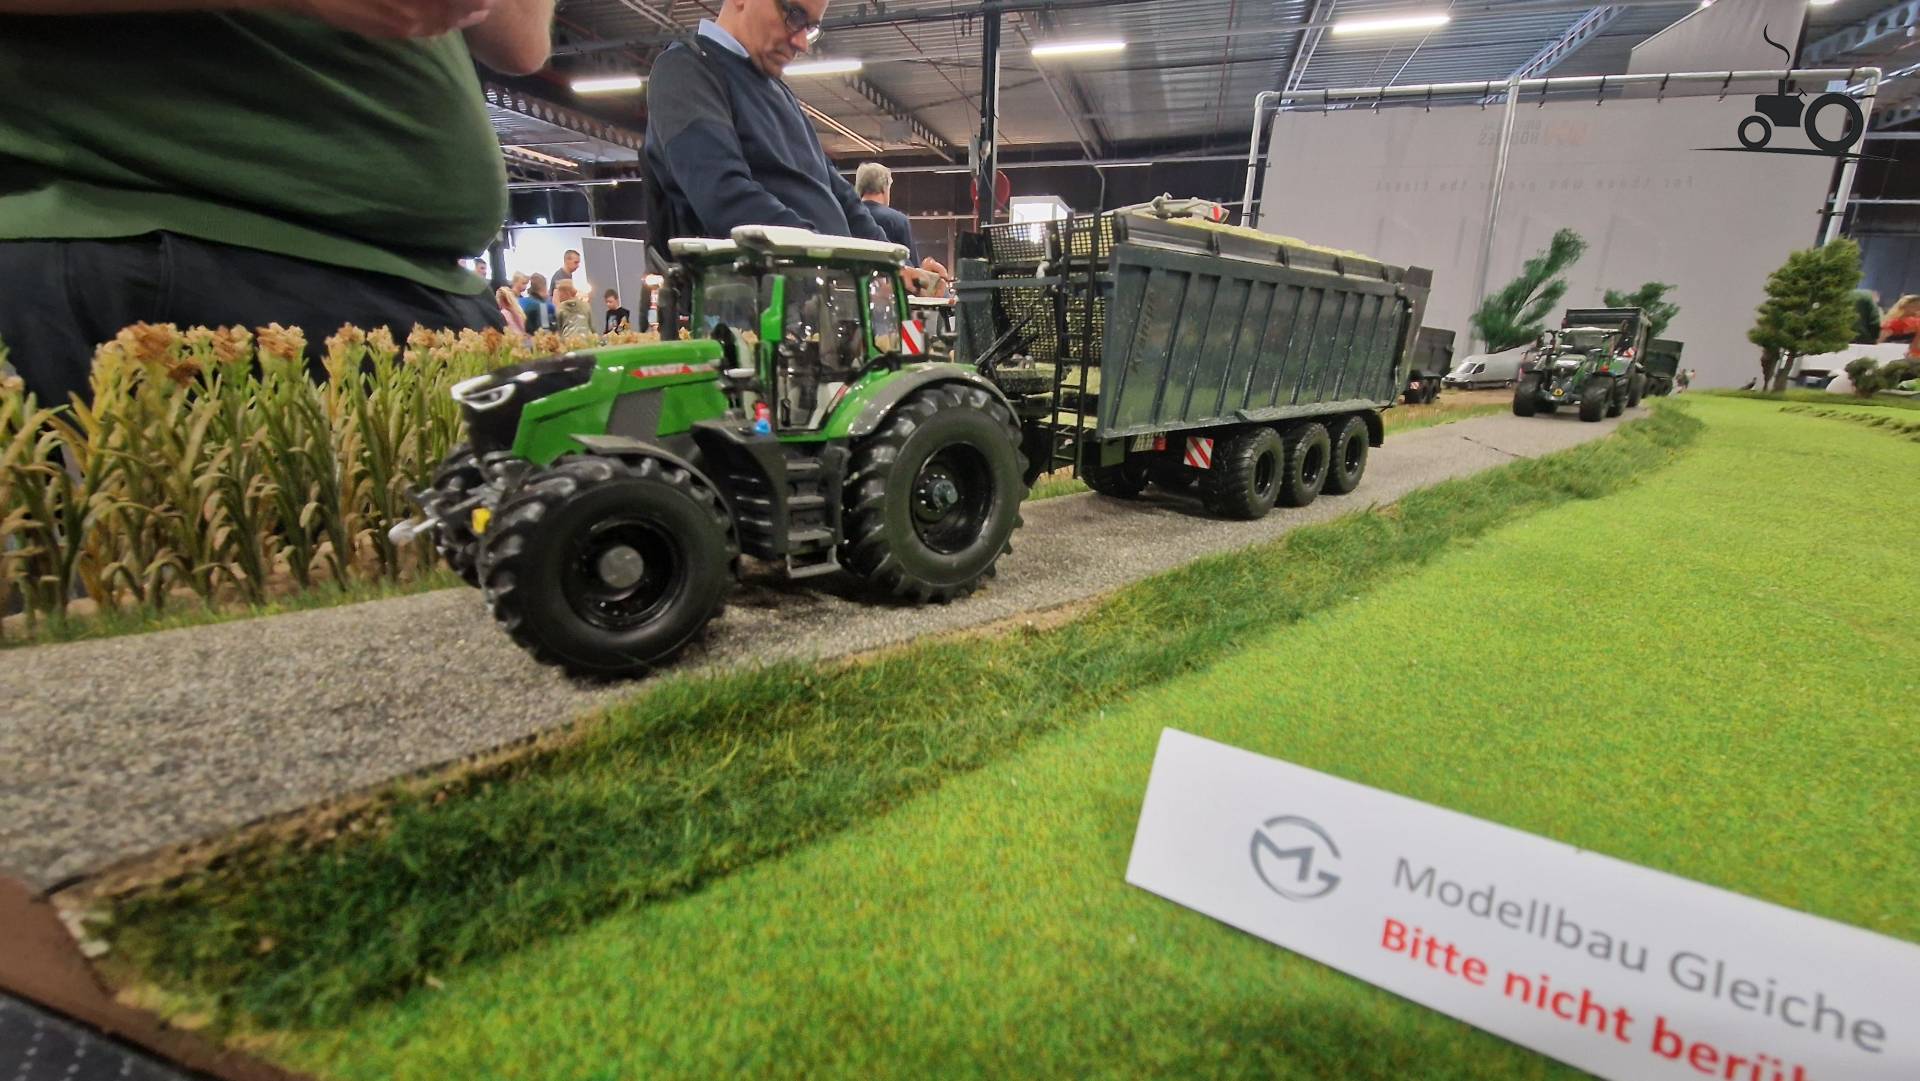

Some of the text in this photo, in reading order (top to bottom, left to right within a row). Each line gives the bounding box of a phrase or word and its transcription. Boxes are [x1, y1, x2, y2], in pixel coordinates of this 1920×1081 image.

[1381, 916, 1489, 987] Bitte
[1503, 969, 1635, 1044] nicht
[1393, 857, 1887, 1054] Modellbau Gleiche
